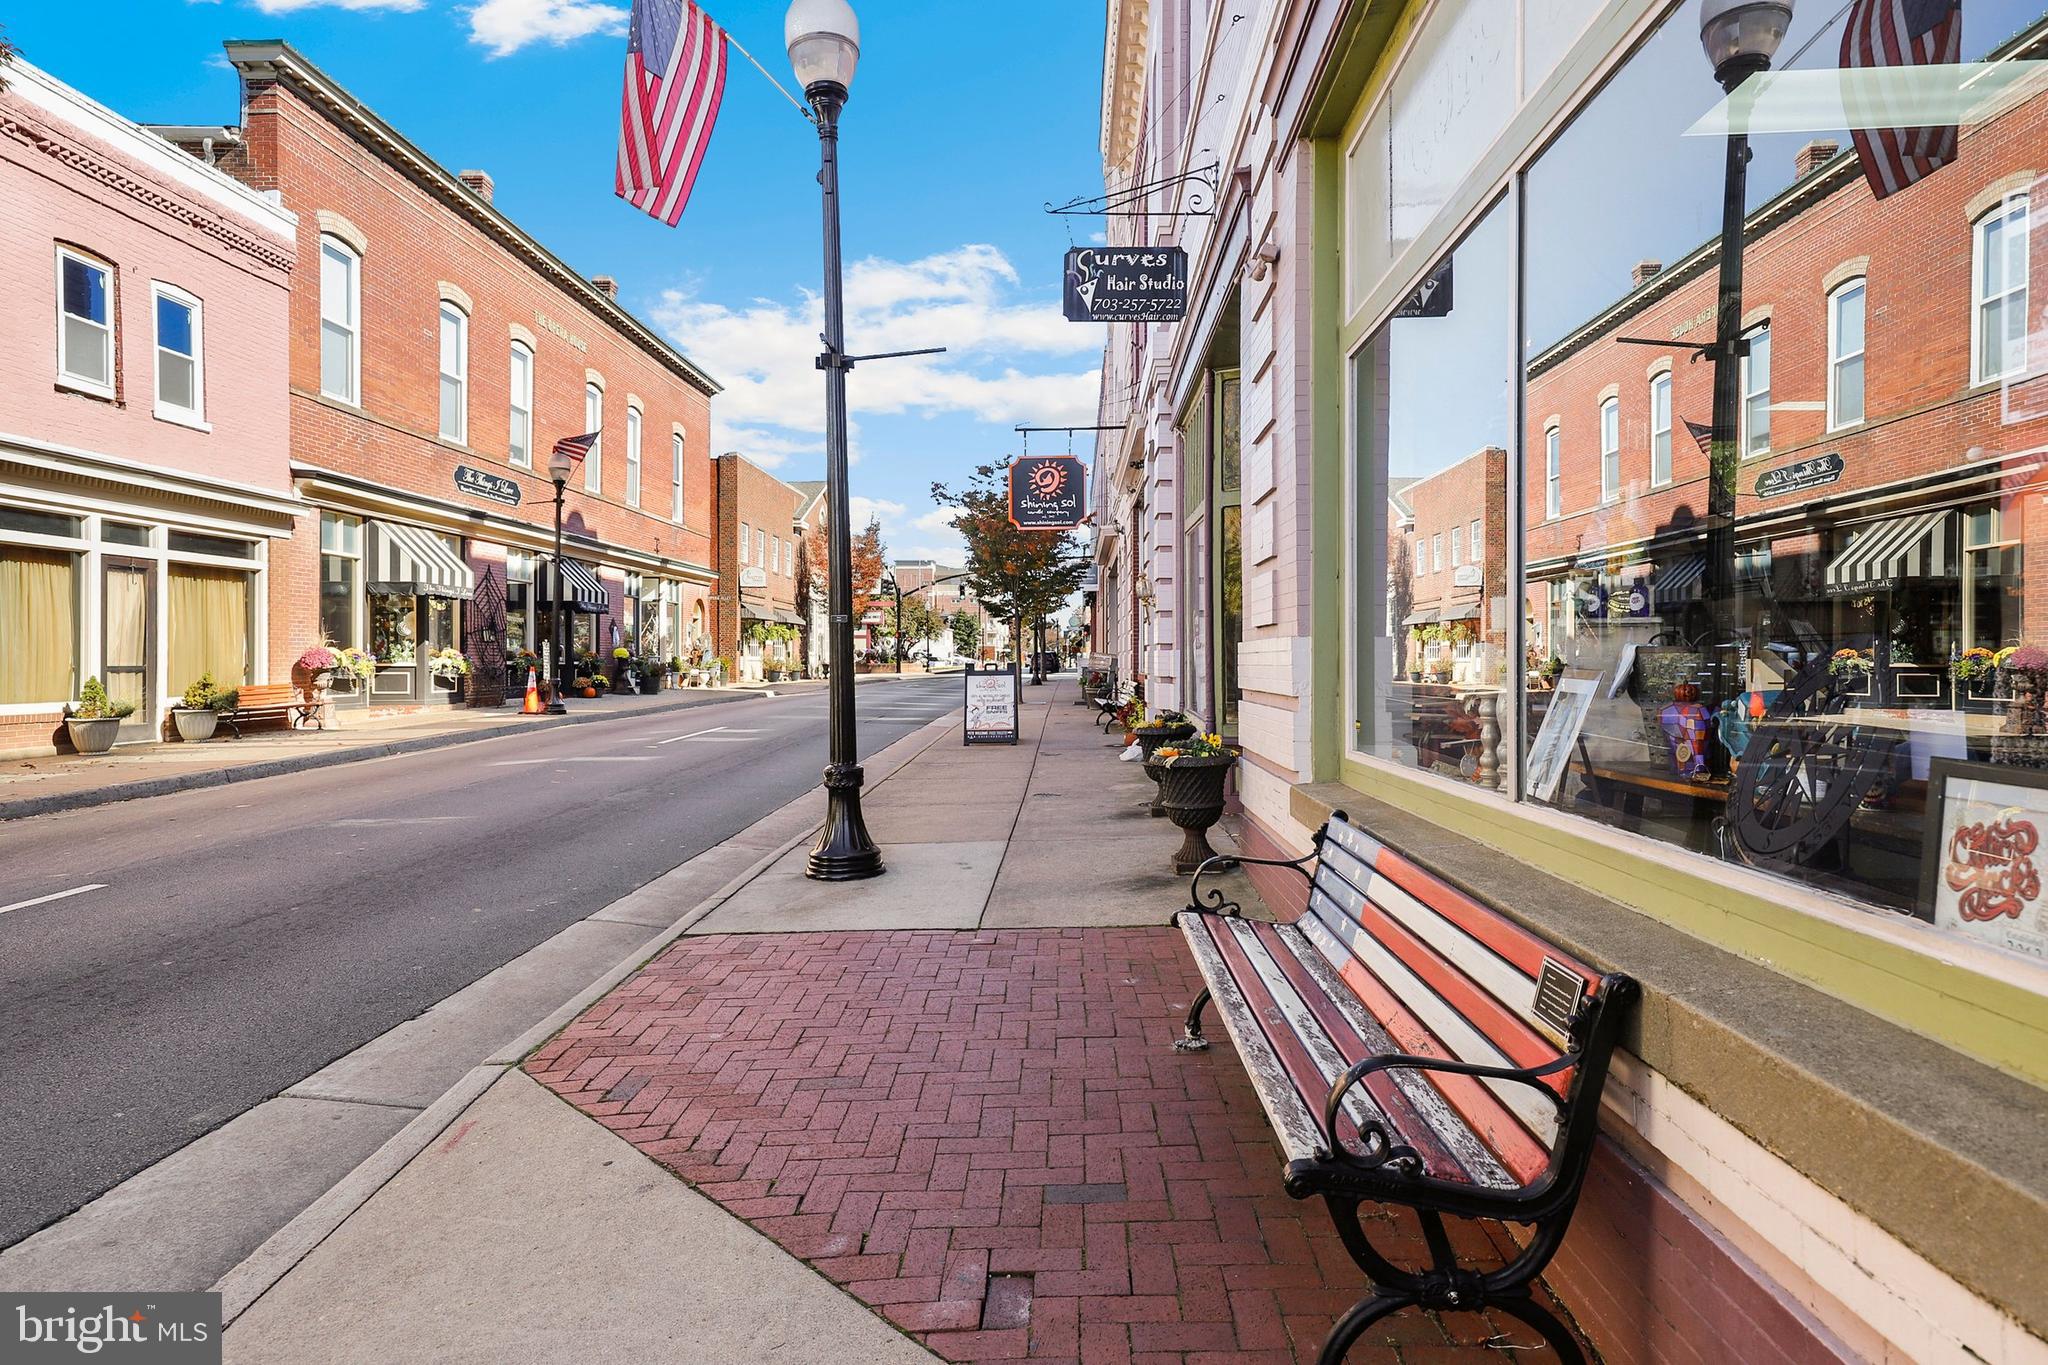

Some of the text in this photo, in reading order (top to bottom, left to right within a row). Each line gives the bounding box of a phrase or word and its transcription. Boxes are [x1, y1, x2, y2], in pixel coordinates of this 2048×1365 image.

[1077, 250, 1168, 274] Curves
[1107, 274, 1185, 291] Hair Studio
[1093, 298, 1181, 311] 703-257-5722
[1021, 494, 1076, 511] shining sol
